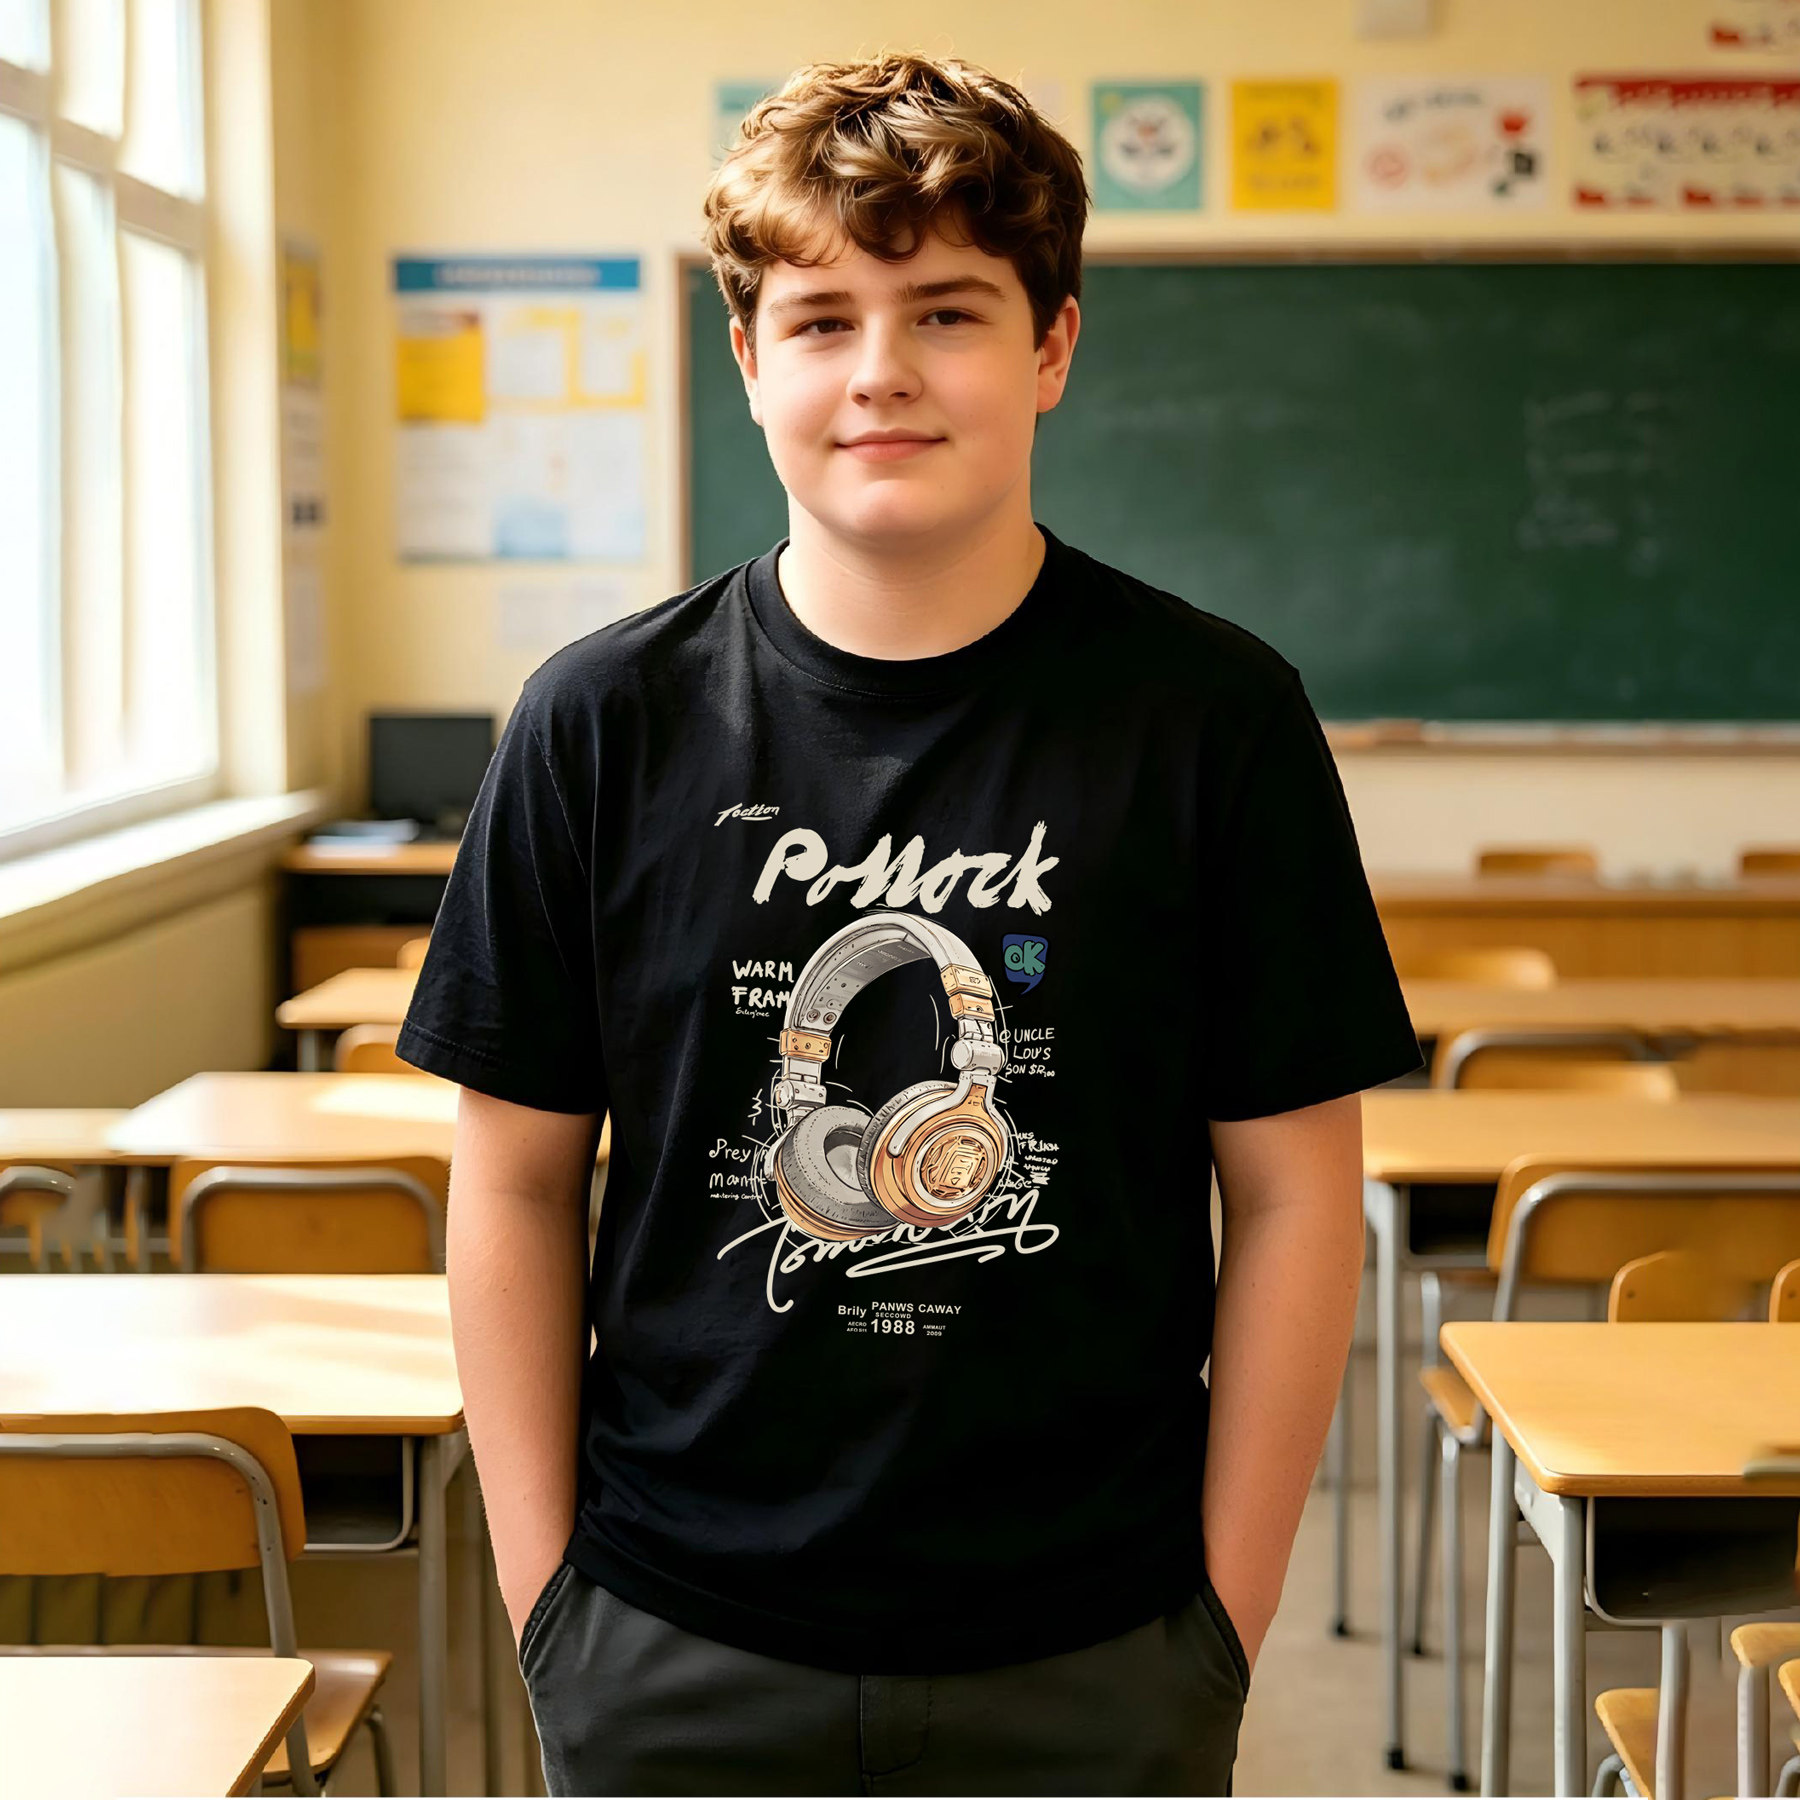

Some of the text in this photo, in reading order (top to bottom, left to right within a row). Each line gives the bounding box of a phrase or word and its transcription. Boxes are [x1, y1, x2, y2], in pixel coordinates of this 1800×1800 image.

[1003, 940, 1046, 976] OK
[732, 959, 795, 983] WARM
[1014, 1027, 1055, 1044] UNCLE
[837, 1301, 962, 1319] Brily PANWS CAWAY
[870, 1318, 916, 1335] 1988
